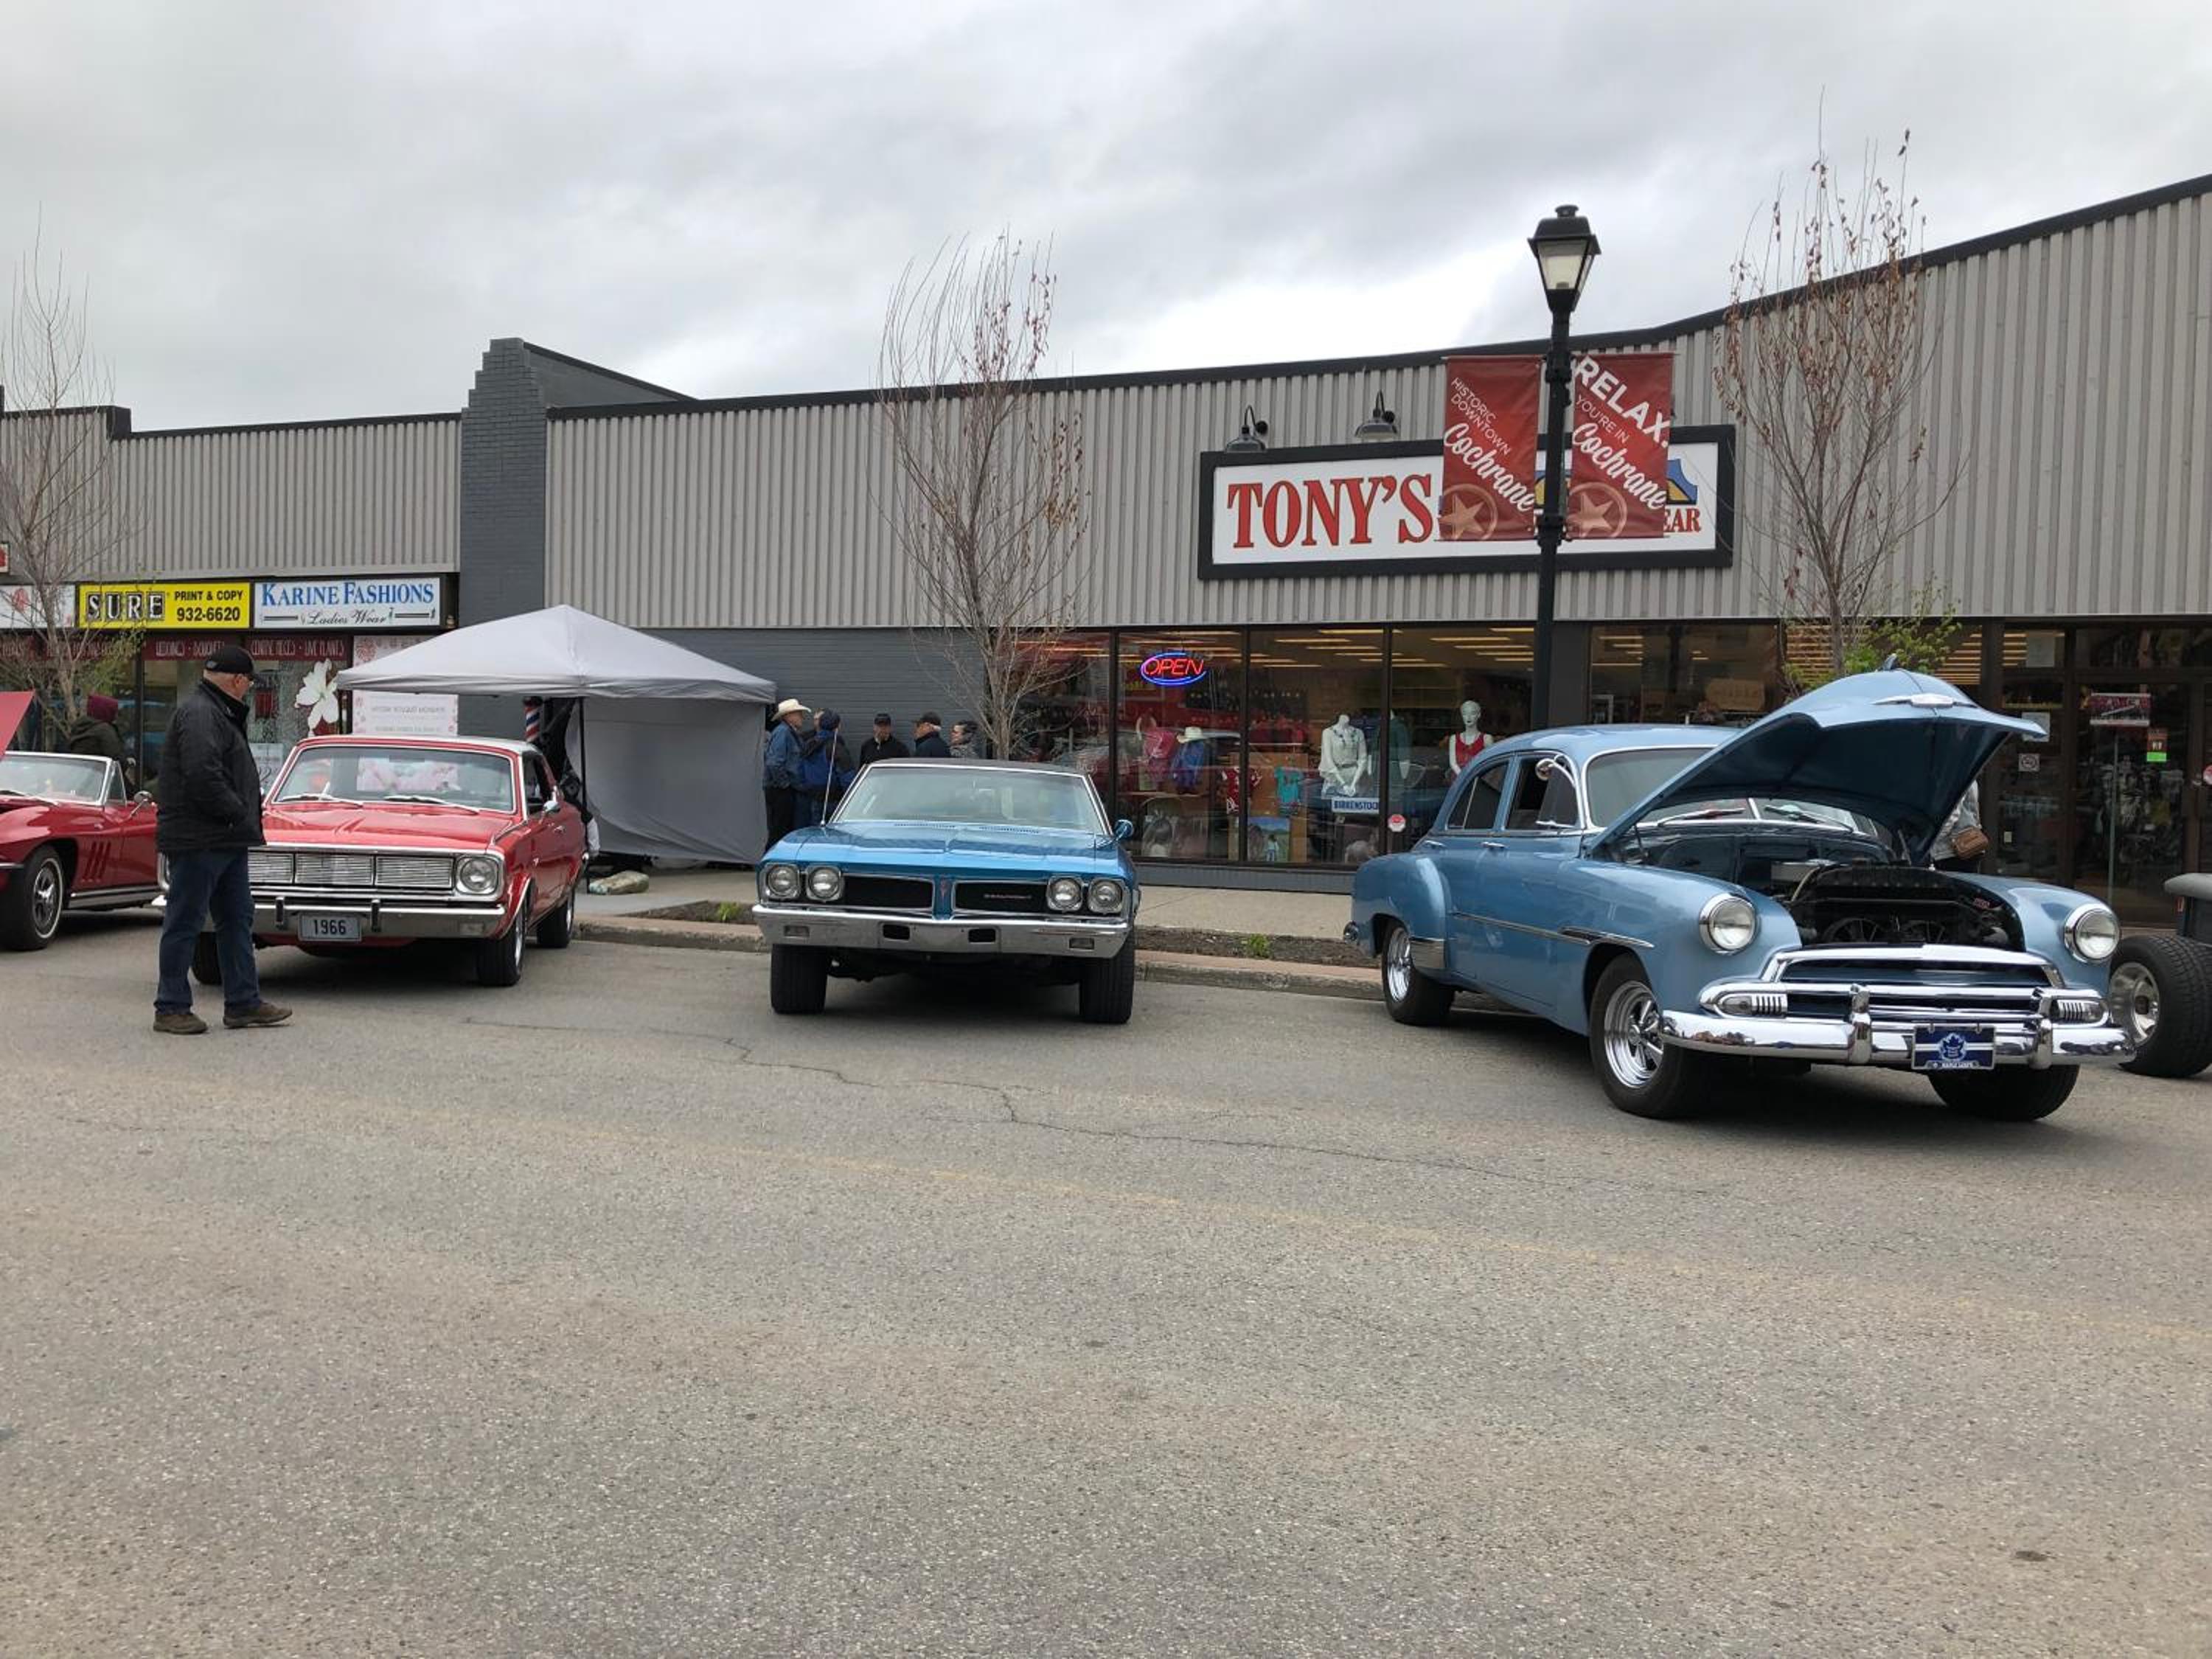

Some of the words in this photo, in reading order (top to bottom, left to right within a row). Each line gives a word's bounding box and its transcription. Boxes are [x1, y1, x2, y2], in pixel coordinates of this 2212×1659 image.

[1450, 377, 1497, 424] HISTORIC
[1574, 355, 1671, 448] RELAX.
[1576, 394, 1617, 434] YOU'RE
[1614, 428, 1630, 443] IN
[1450, 393, 1512, 456] DOWNTOWN
[1443, 422, 1534, 512] Cochrane
[1572, 422, 1666, 509] Cochrane
[1227, 473, 1433, 549] TONY'S
[88, 593, 164, 620] SURE
[174, 591, 203, 601] PRINT
[206, 591, 213, 601] &
[216, 590, 243, 601] COPY
[262, 583, 339, 606] KARINE
[343, 582, 434, 605] FASHIONS
[307, 611, 348, 625] Ladies
[350, 608, 386, 624] Wear
[1144, 658, 1204, 675] OPEN
[1334, 801, 1379, 810] BIRKENSTOC
[314, 919, 346, 935] 1966
